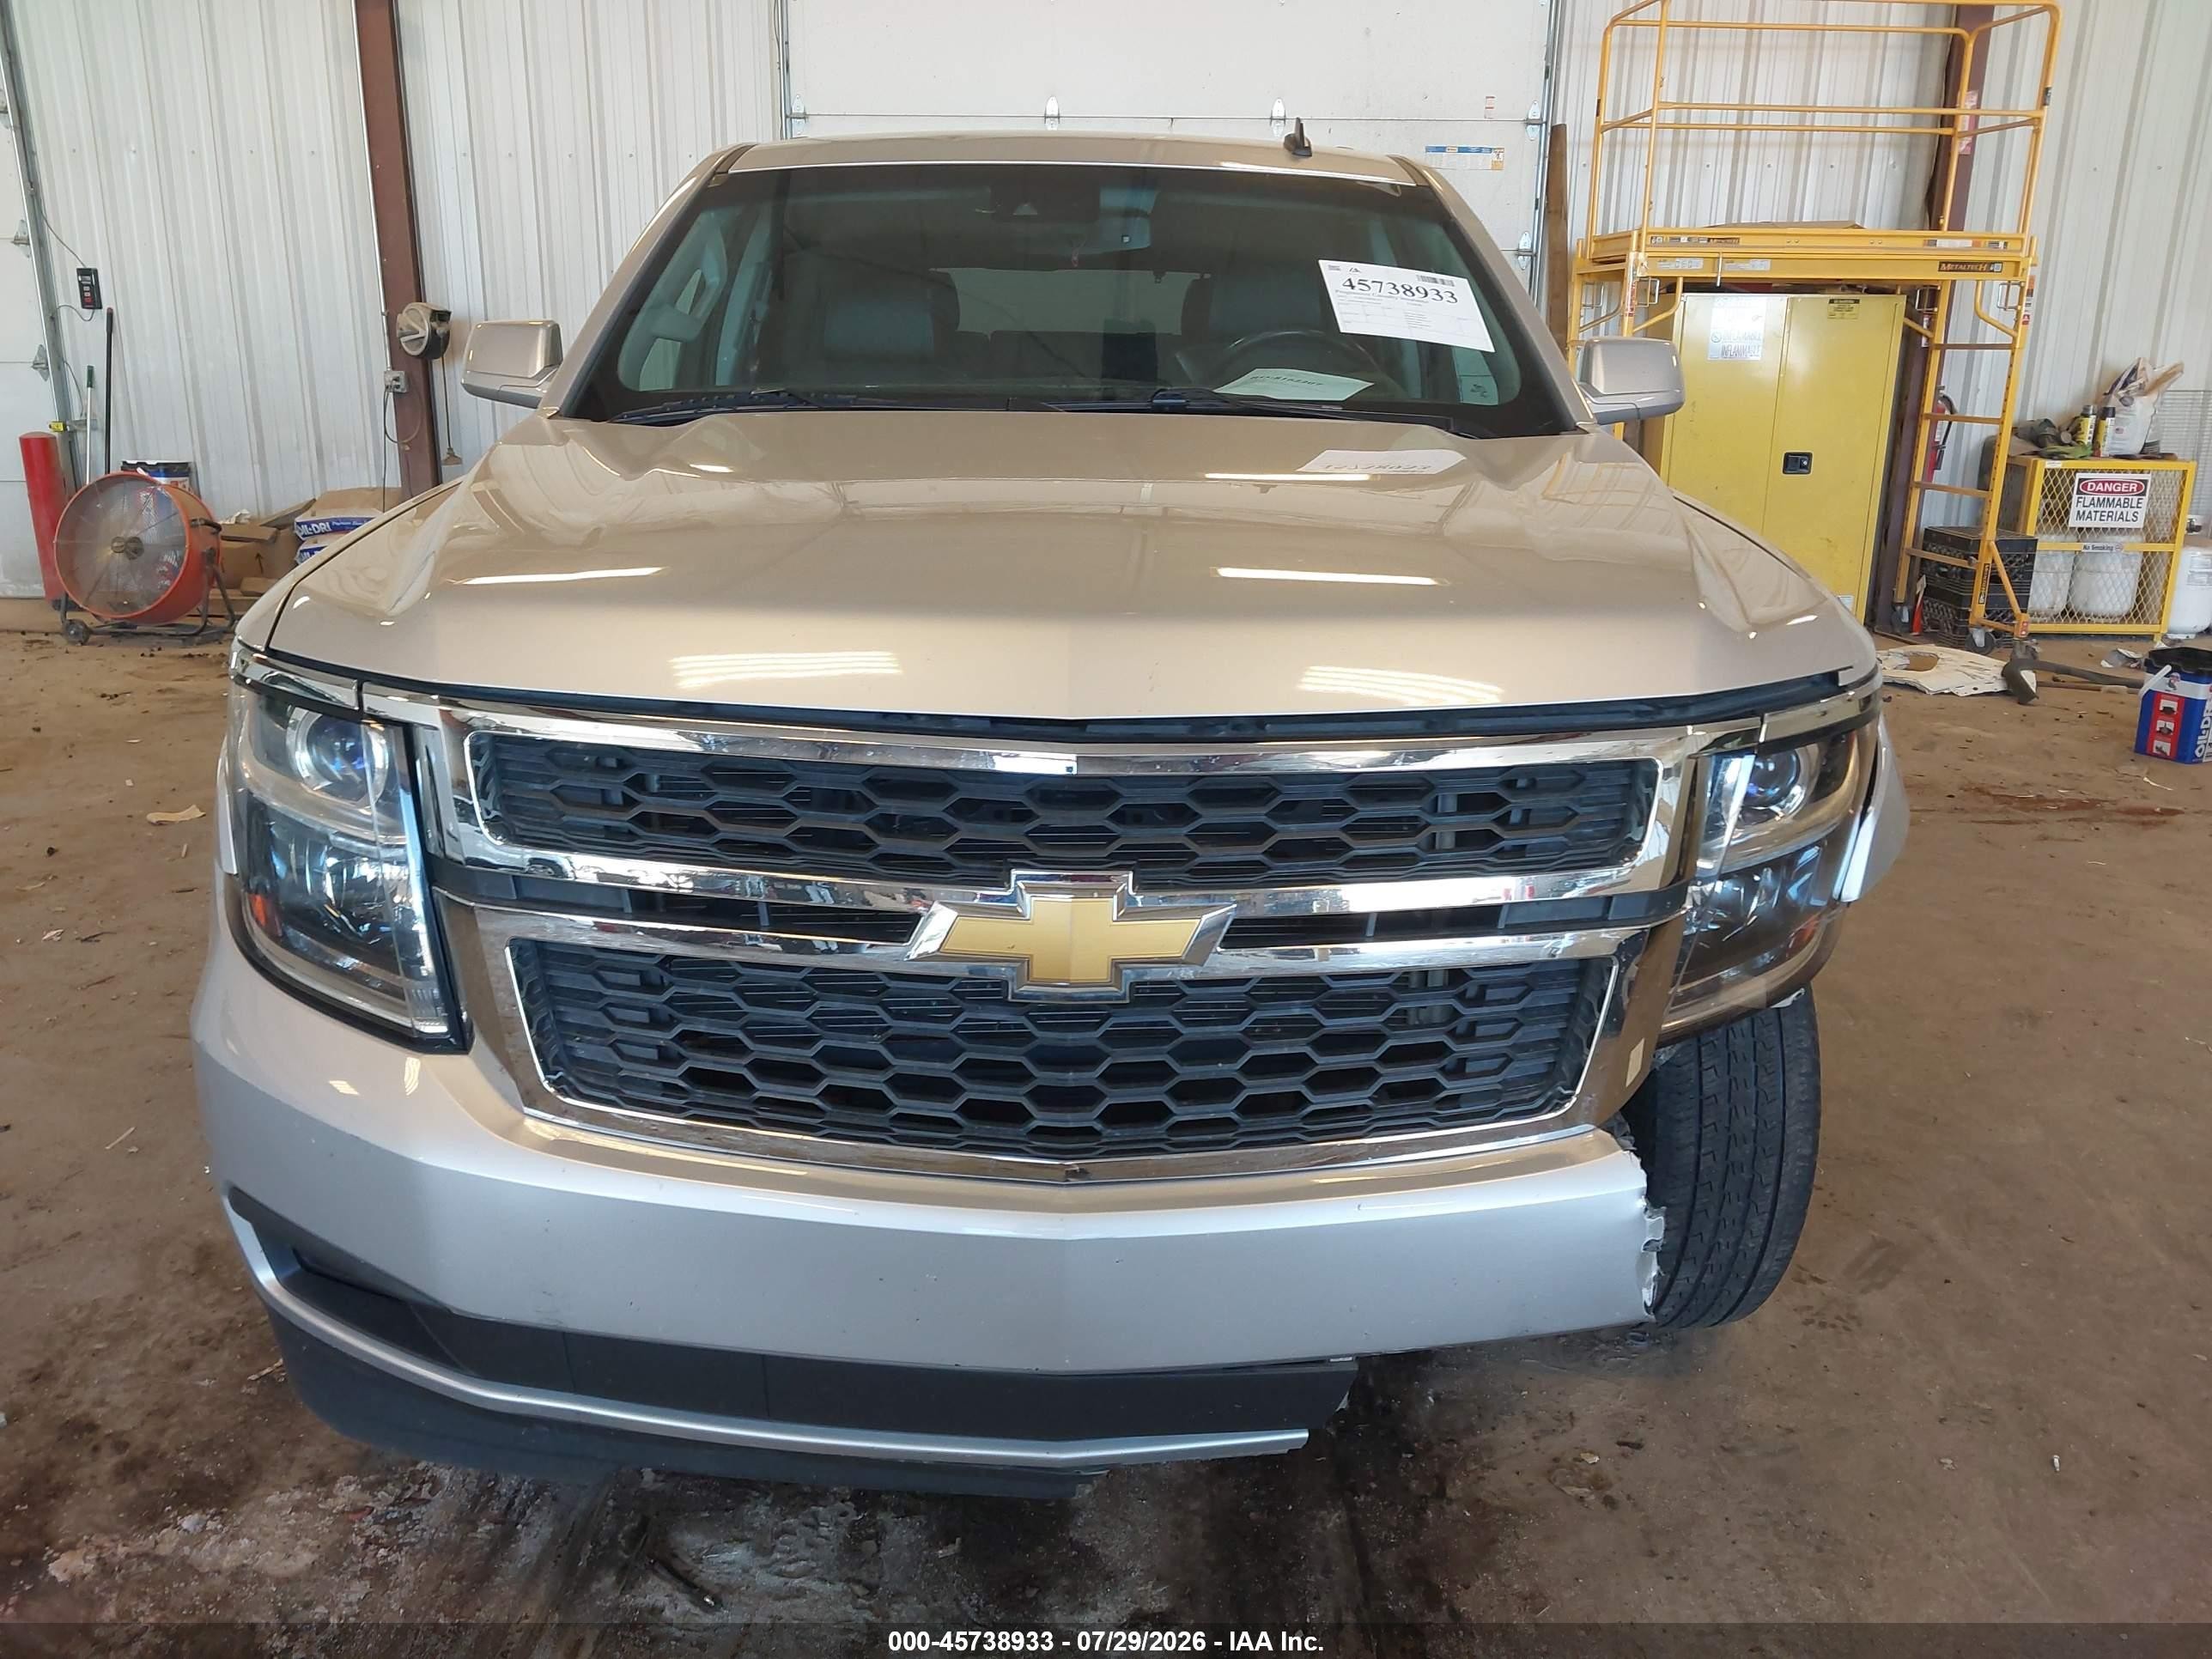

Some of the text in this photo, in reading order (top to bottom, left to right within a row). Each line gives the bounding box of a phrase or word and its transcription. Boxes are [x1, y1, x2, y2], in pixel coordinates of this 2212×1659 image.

[1342, 276, 1458, 305] 45738933
[2087, 482, 2137, 492] DANGER
[2075, 496, 2143, 509] FLAMMABLE
[2075, 510, 2139, 522] MATERIALS
